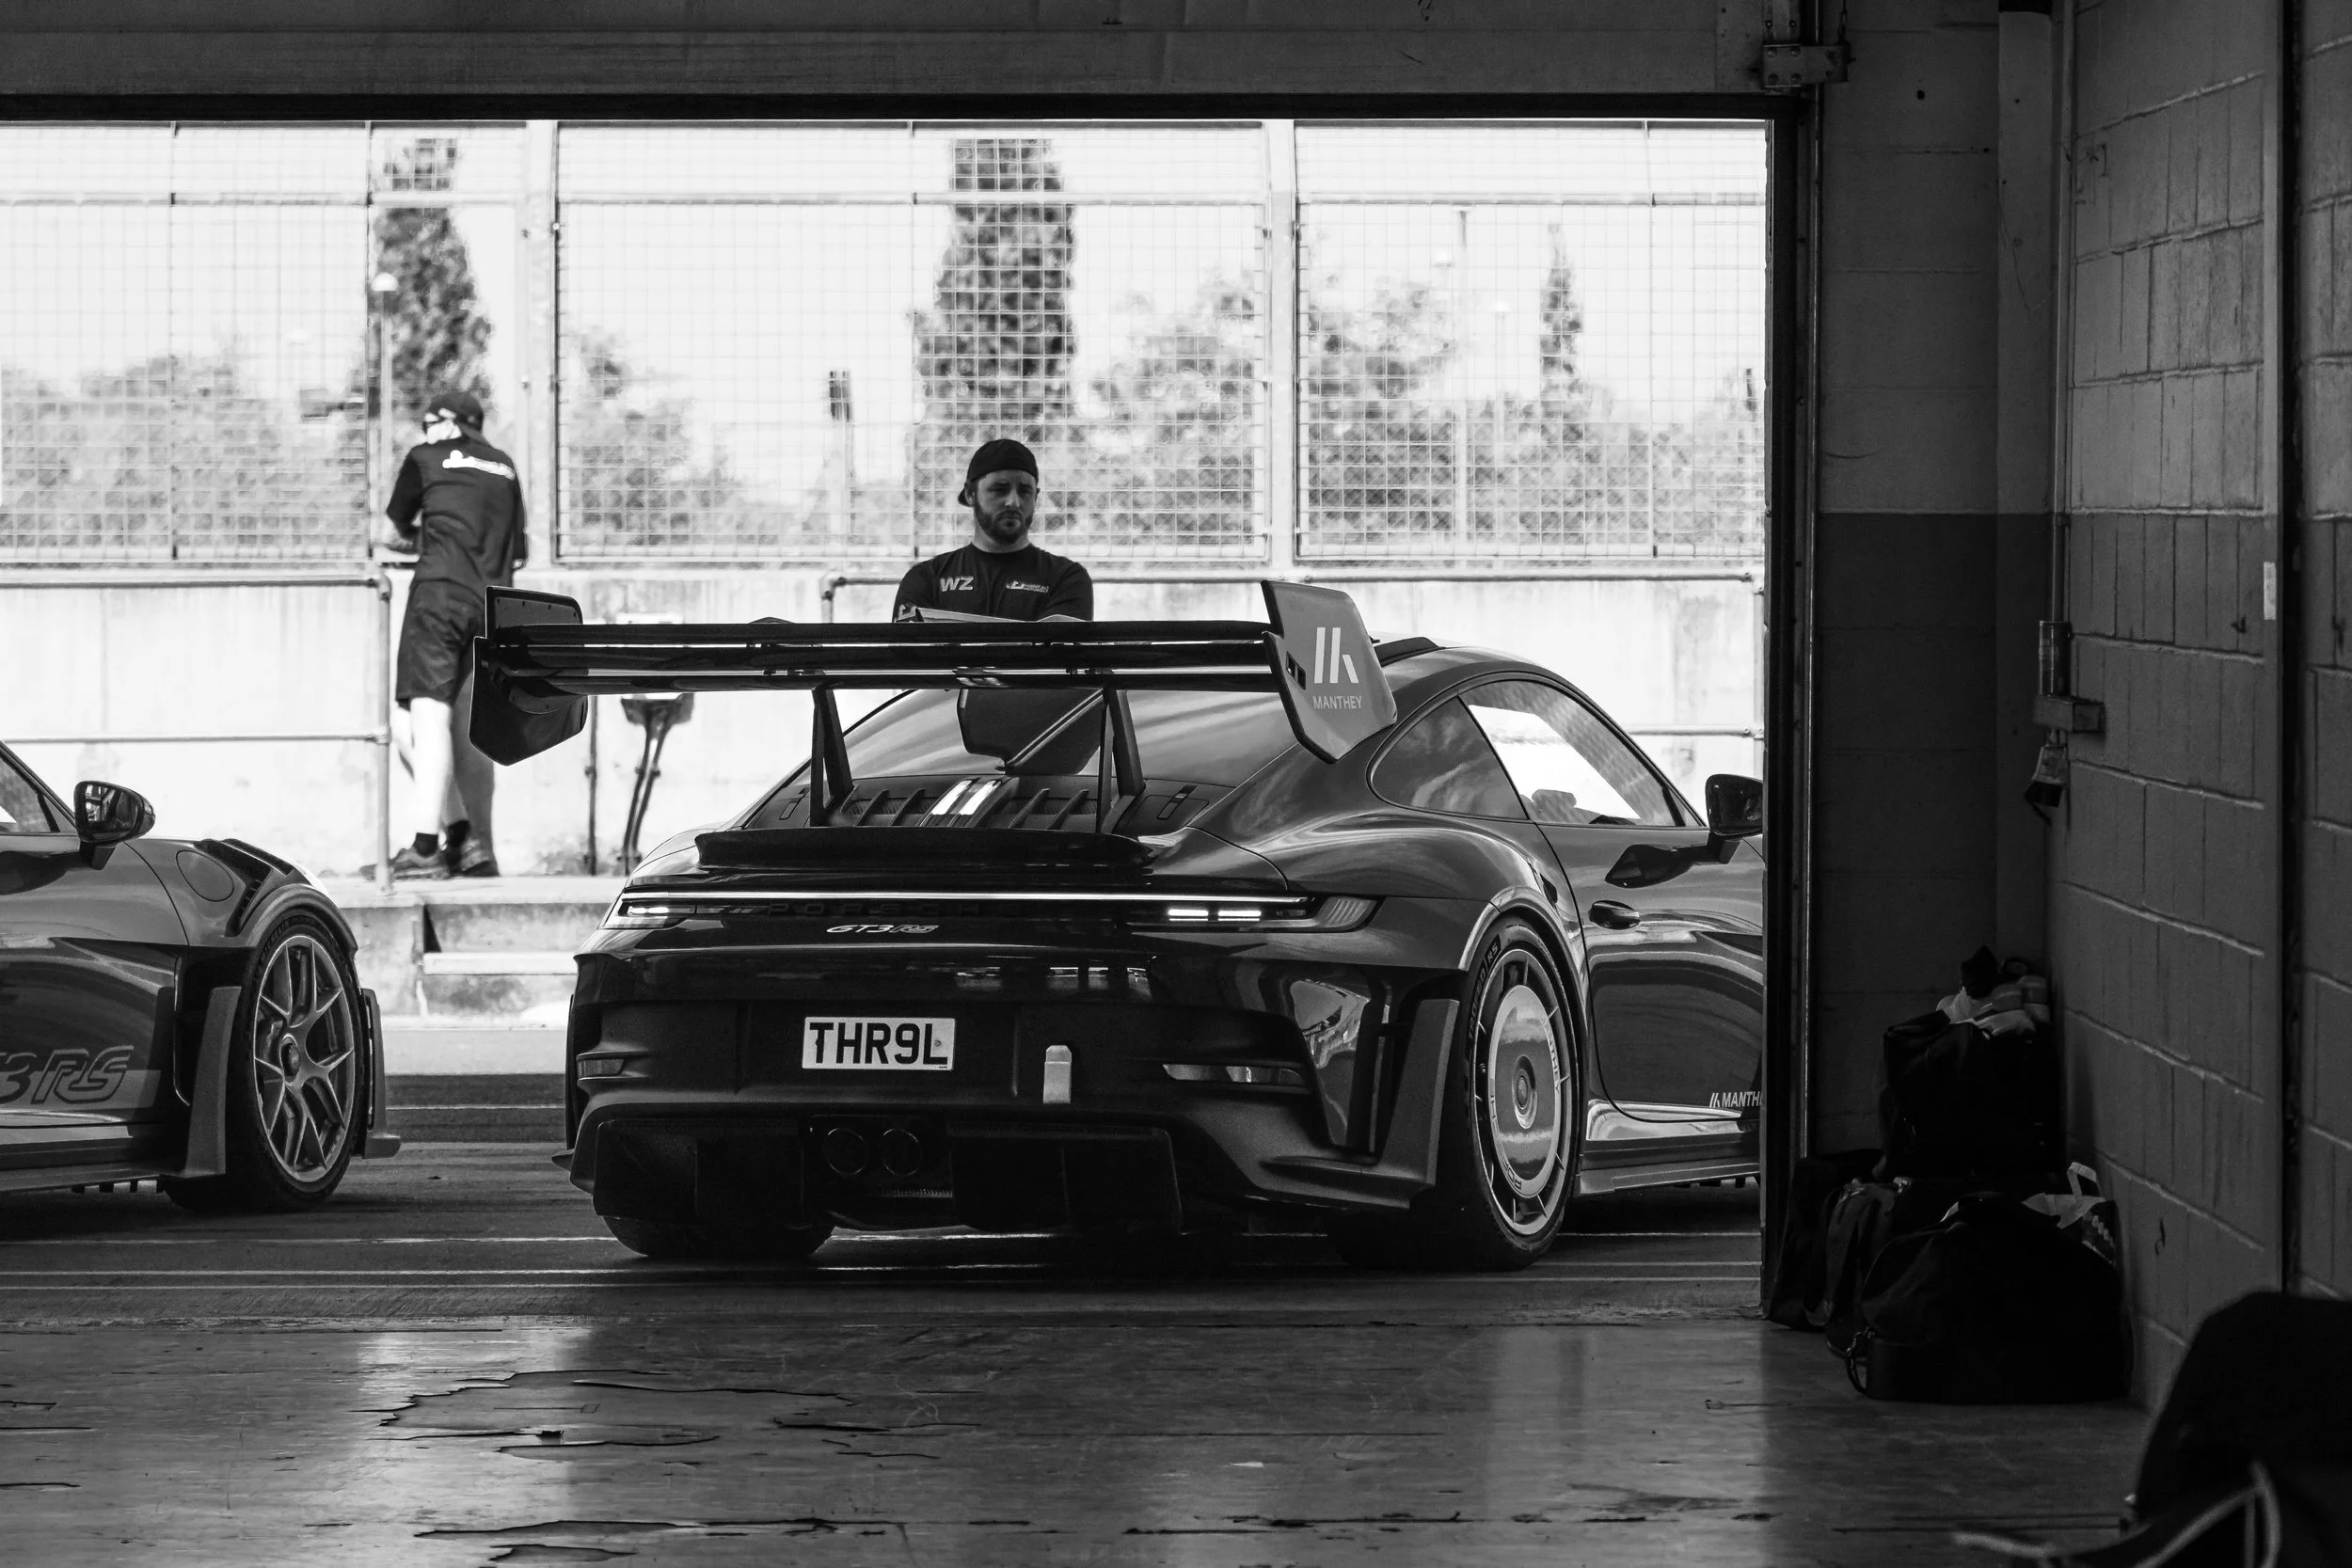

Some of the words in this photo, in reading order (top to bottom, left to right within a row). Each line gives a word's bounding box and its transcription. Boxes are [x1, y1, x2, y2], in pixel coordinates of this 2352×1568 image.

[940, 577, 974, 592] WZ
[1312, 696, 1362, 709] MANTHEY
[1469, 967, 1486, 1040] TROFEO
[1486, 942, 1499, 963] RS
[809, 1022, 948, 1065] THR9L
